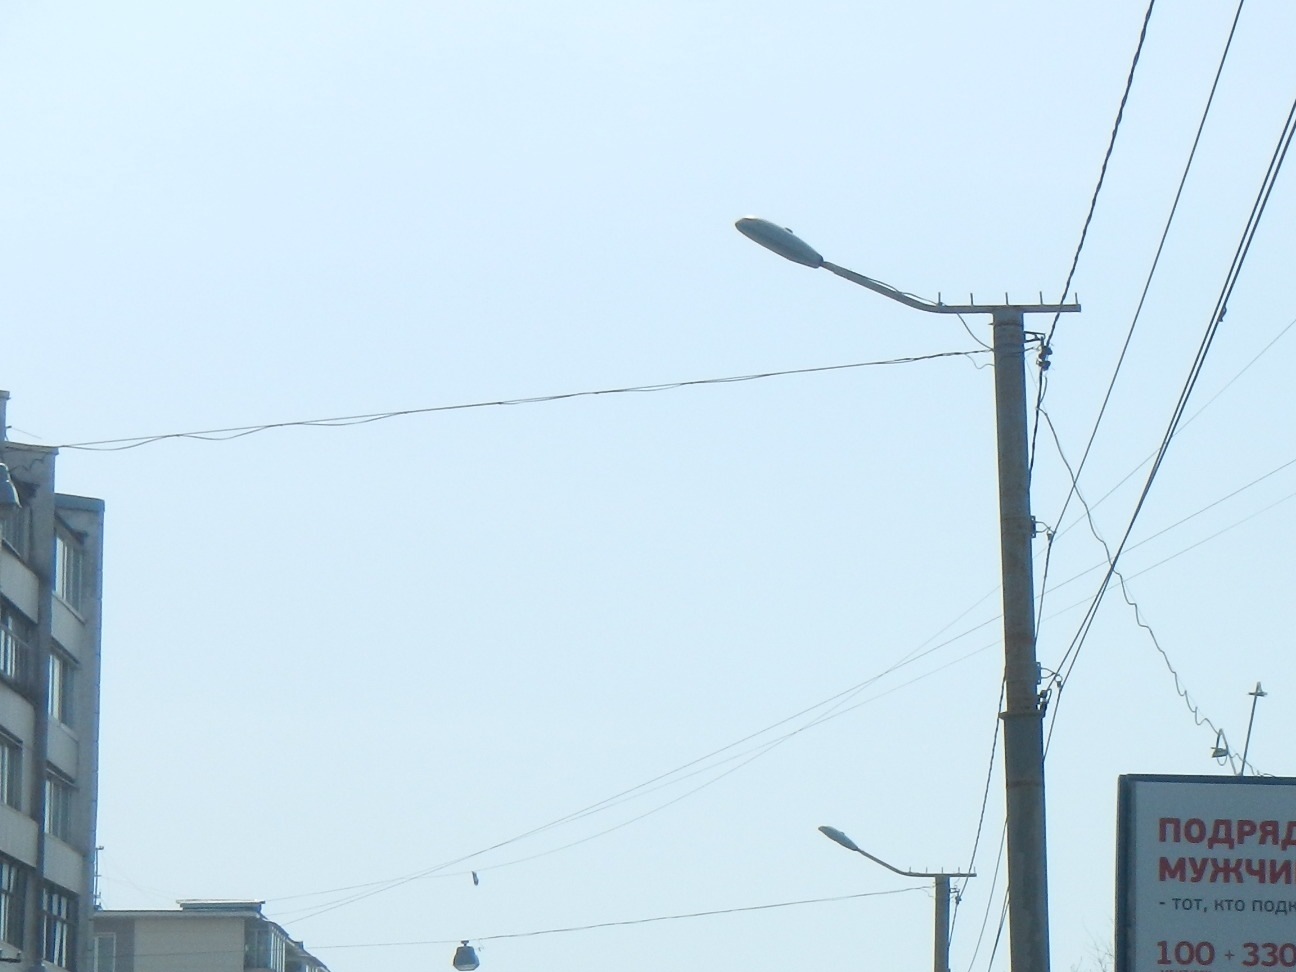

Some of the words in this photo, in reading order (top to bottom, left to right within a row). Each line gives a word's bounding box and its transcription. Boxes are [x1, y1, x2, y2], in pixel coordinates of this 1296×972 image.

[1172, 897, 1208, 913] тот,
[1214, 897, 1245, 912] кто
[1156, 941, 1215, 966] 100
